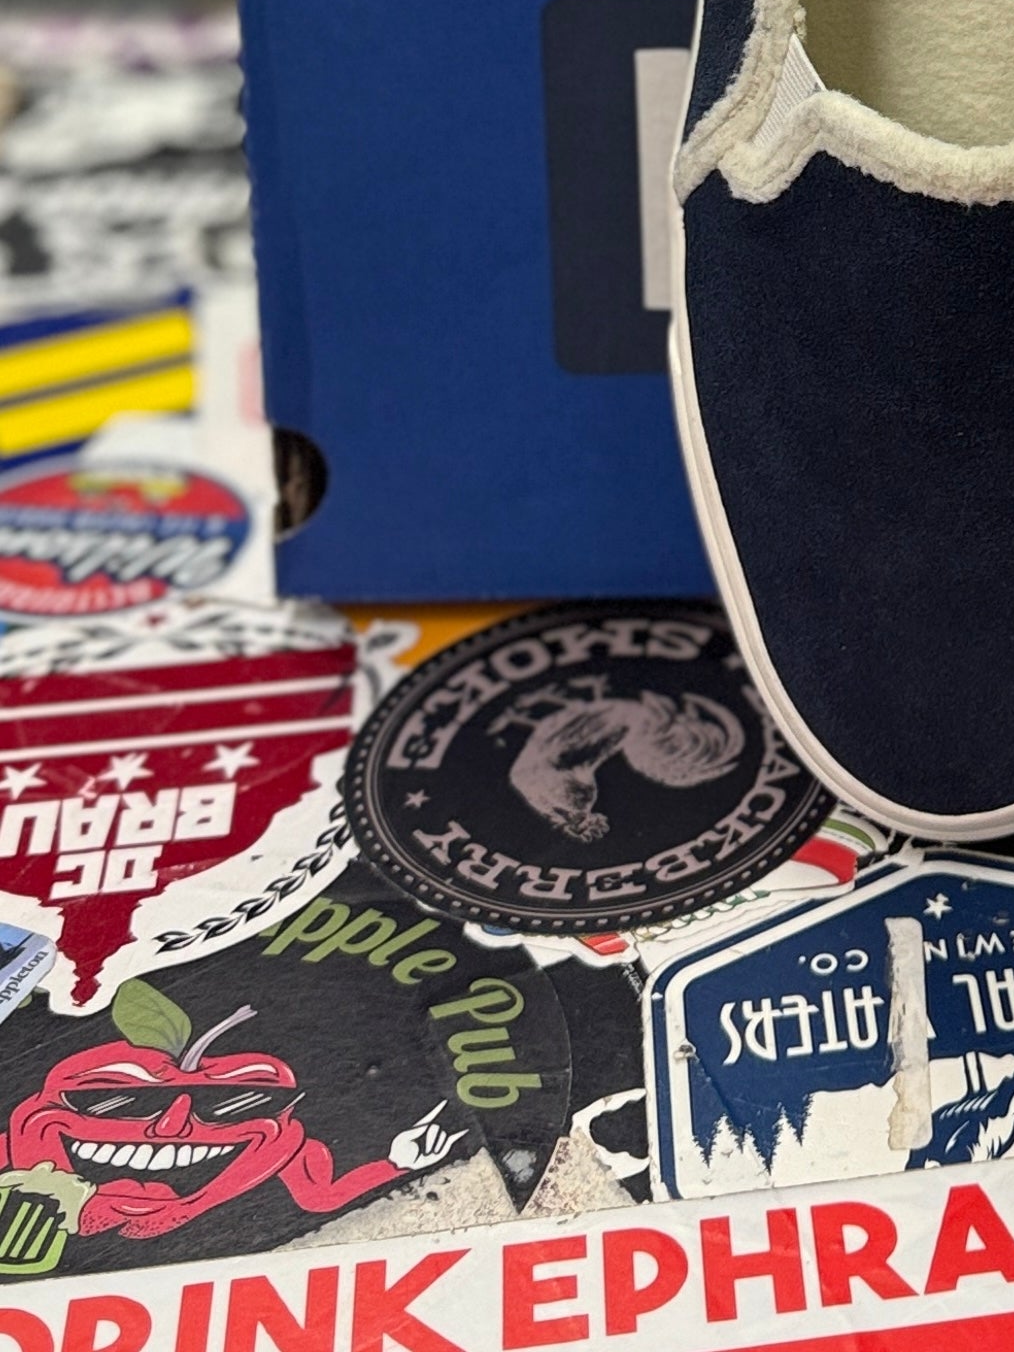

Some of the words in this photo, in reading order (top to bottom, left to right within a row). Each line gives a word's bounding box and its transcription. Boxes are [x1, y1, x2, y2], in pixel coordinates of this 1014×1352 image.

[386, 618, 712, 770] SMOKE
[0, 782, 238, 857] BRAU
[49, 845, 164, 900] DC
[0, 951, 49, 1004] ppleton
[799, 949, 870, 976] CO.
[428, 977, 543, 1109] Pub
[720, 983, 934, 1066] ATERS
[0, 1248, 472, 1352] RINK
